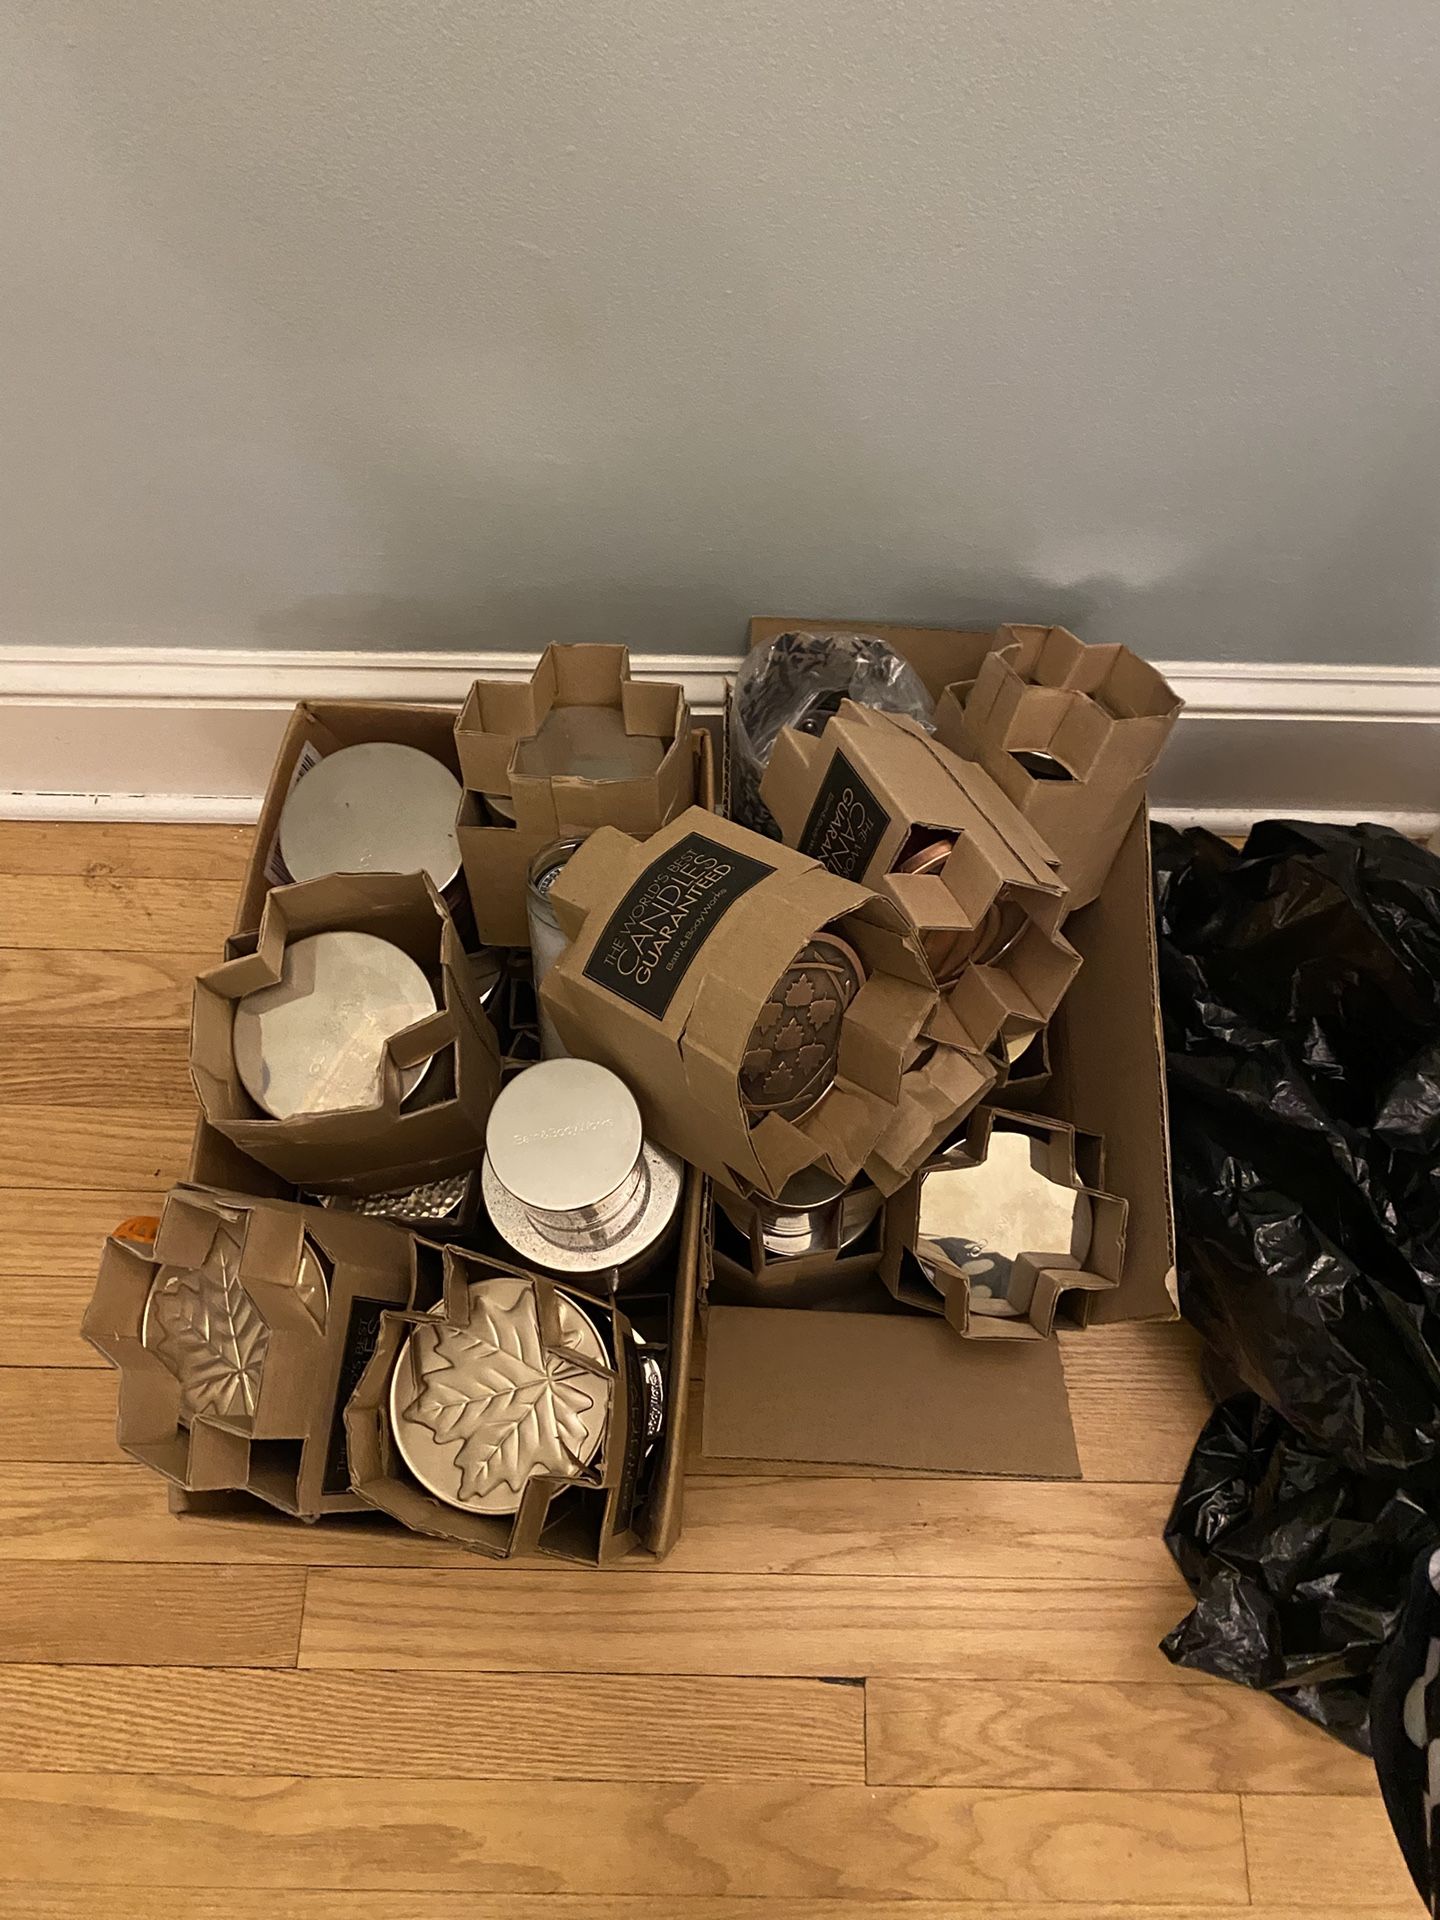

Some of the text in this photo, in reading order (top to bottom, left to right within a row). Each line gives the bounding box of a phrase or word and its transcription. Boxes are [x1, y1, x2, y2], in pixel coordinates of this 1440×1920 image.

[817, 787, 855, 862] GUARAN
[603, 848, 698, 967] THE WORLD'S BEST
[616, 853, 719, 976] CANDLES
[635, 863, 732, 985] GUARANTEED
